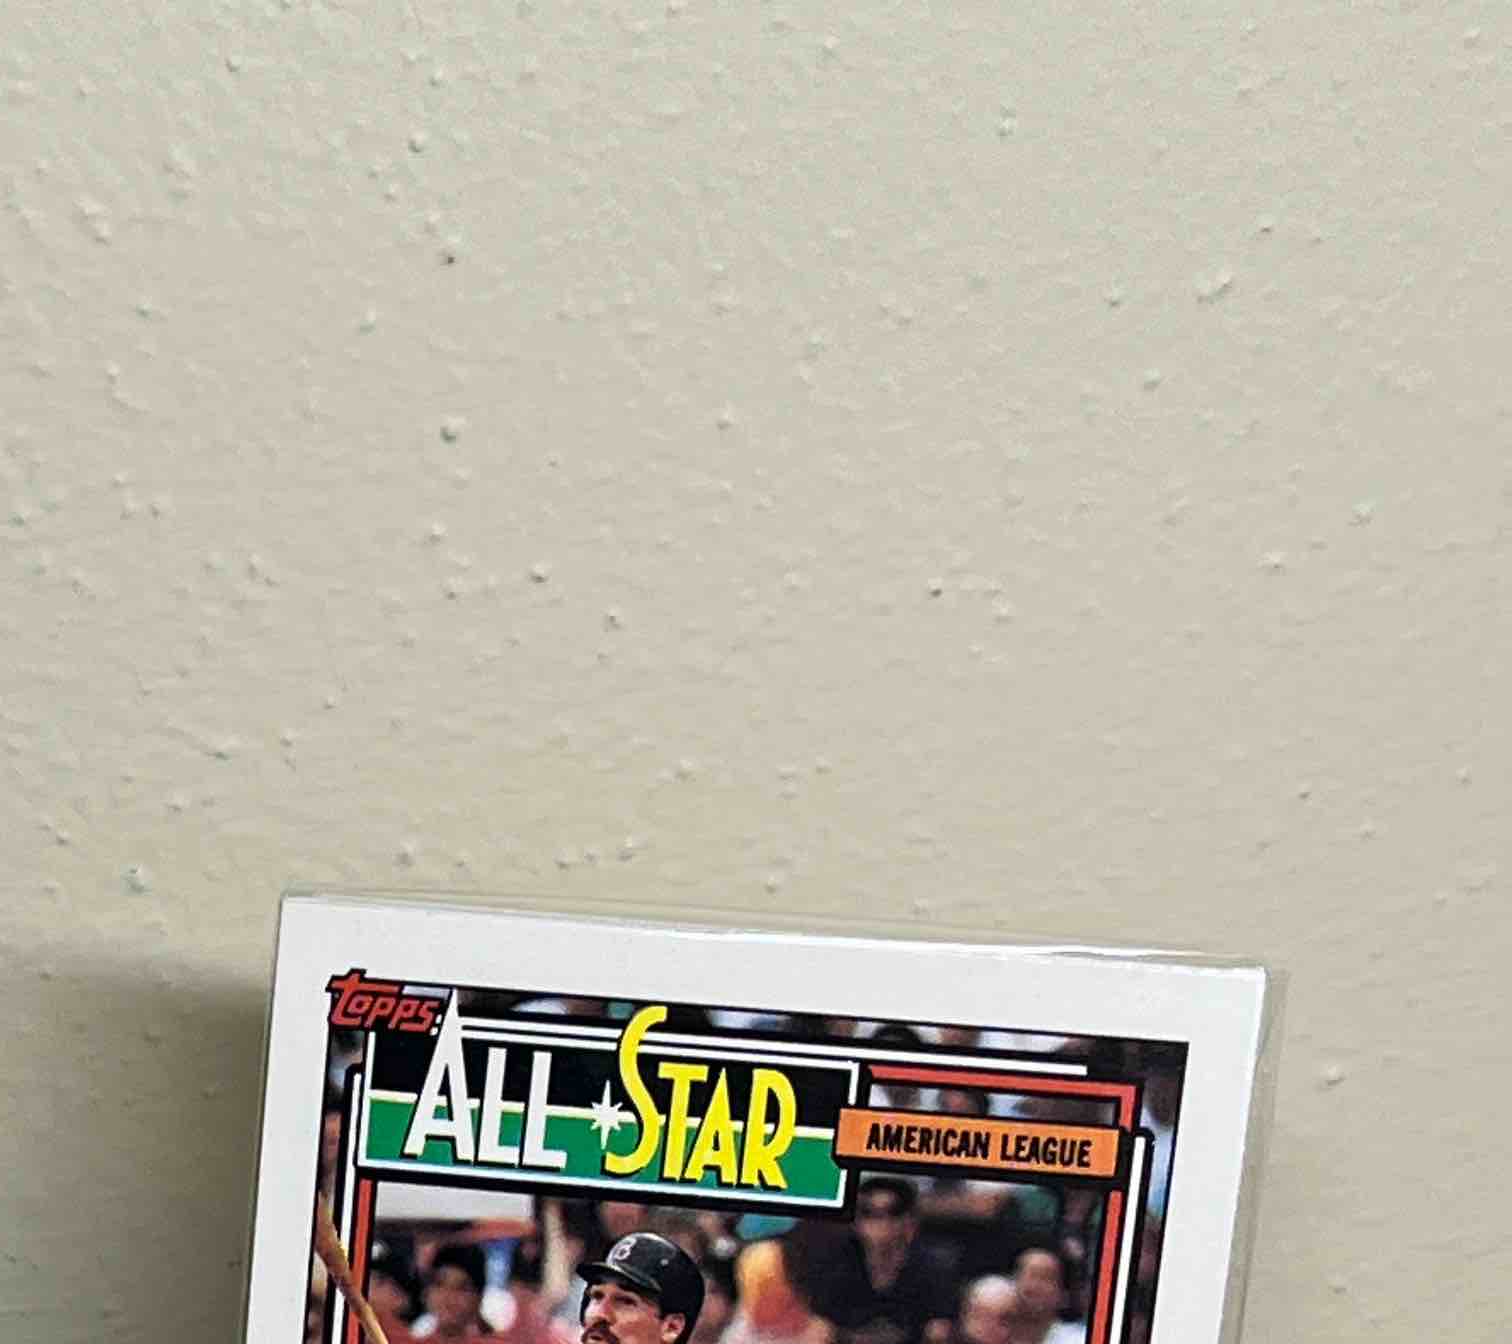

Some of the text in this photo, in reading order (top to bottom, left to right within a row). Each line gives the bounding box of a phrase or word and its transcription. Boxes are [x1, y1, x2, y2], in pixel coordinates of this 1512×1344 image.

[328, 970, 440, 1032] Topps
[402, 988, 797, 1190] ALL STAR
[865, 1124, 1093, 1169] AMERICAN LEAGUE
